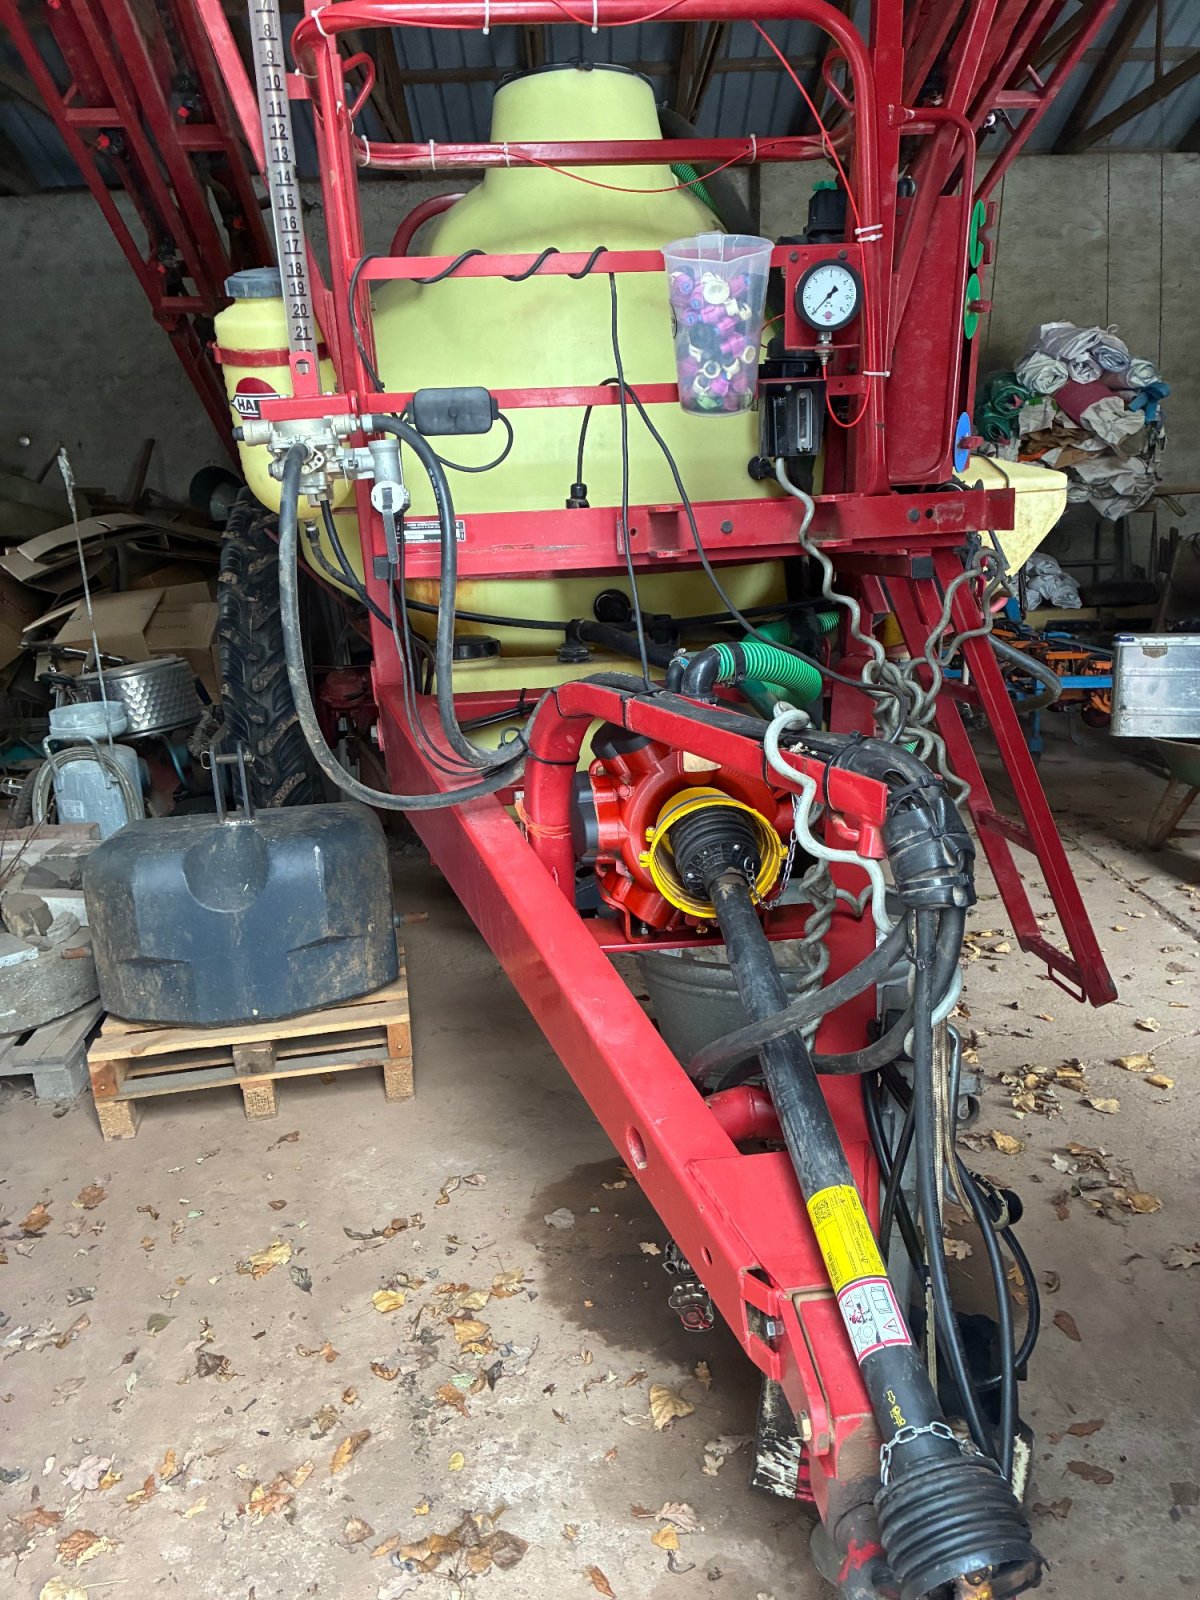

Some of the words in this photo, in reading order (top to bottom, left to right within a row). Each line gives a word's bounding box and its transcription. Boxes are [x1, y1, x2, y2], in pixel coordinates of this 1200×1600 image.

[264, 23, 271, 37] 8
[266, 50, 274, 64] 9
[267, 75, 280, 88] 10
[270, 102, 282, 115] 11
[271, 123, 286, 137] 12
[274, 147, 288, 160] 13
[278, 171, 291, 184] 14
[280, 193, 294, 207] 15
[283, 216, 297, 229] 16
[286, 239, 299, 252] 17
[289, 262, 302, 275] 18
[291, 281, 305, 295] 19
[293, 303, 307, 316] 20
[296, 325, 309, 338] 21
[237, 398, 259, 411] HA
